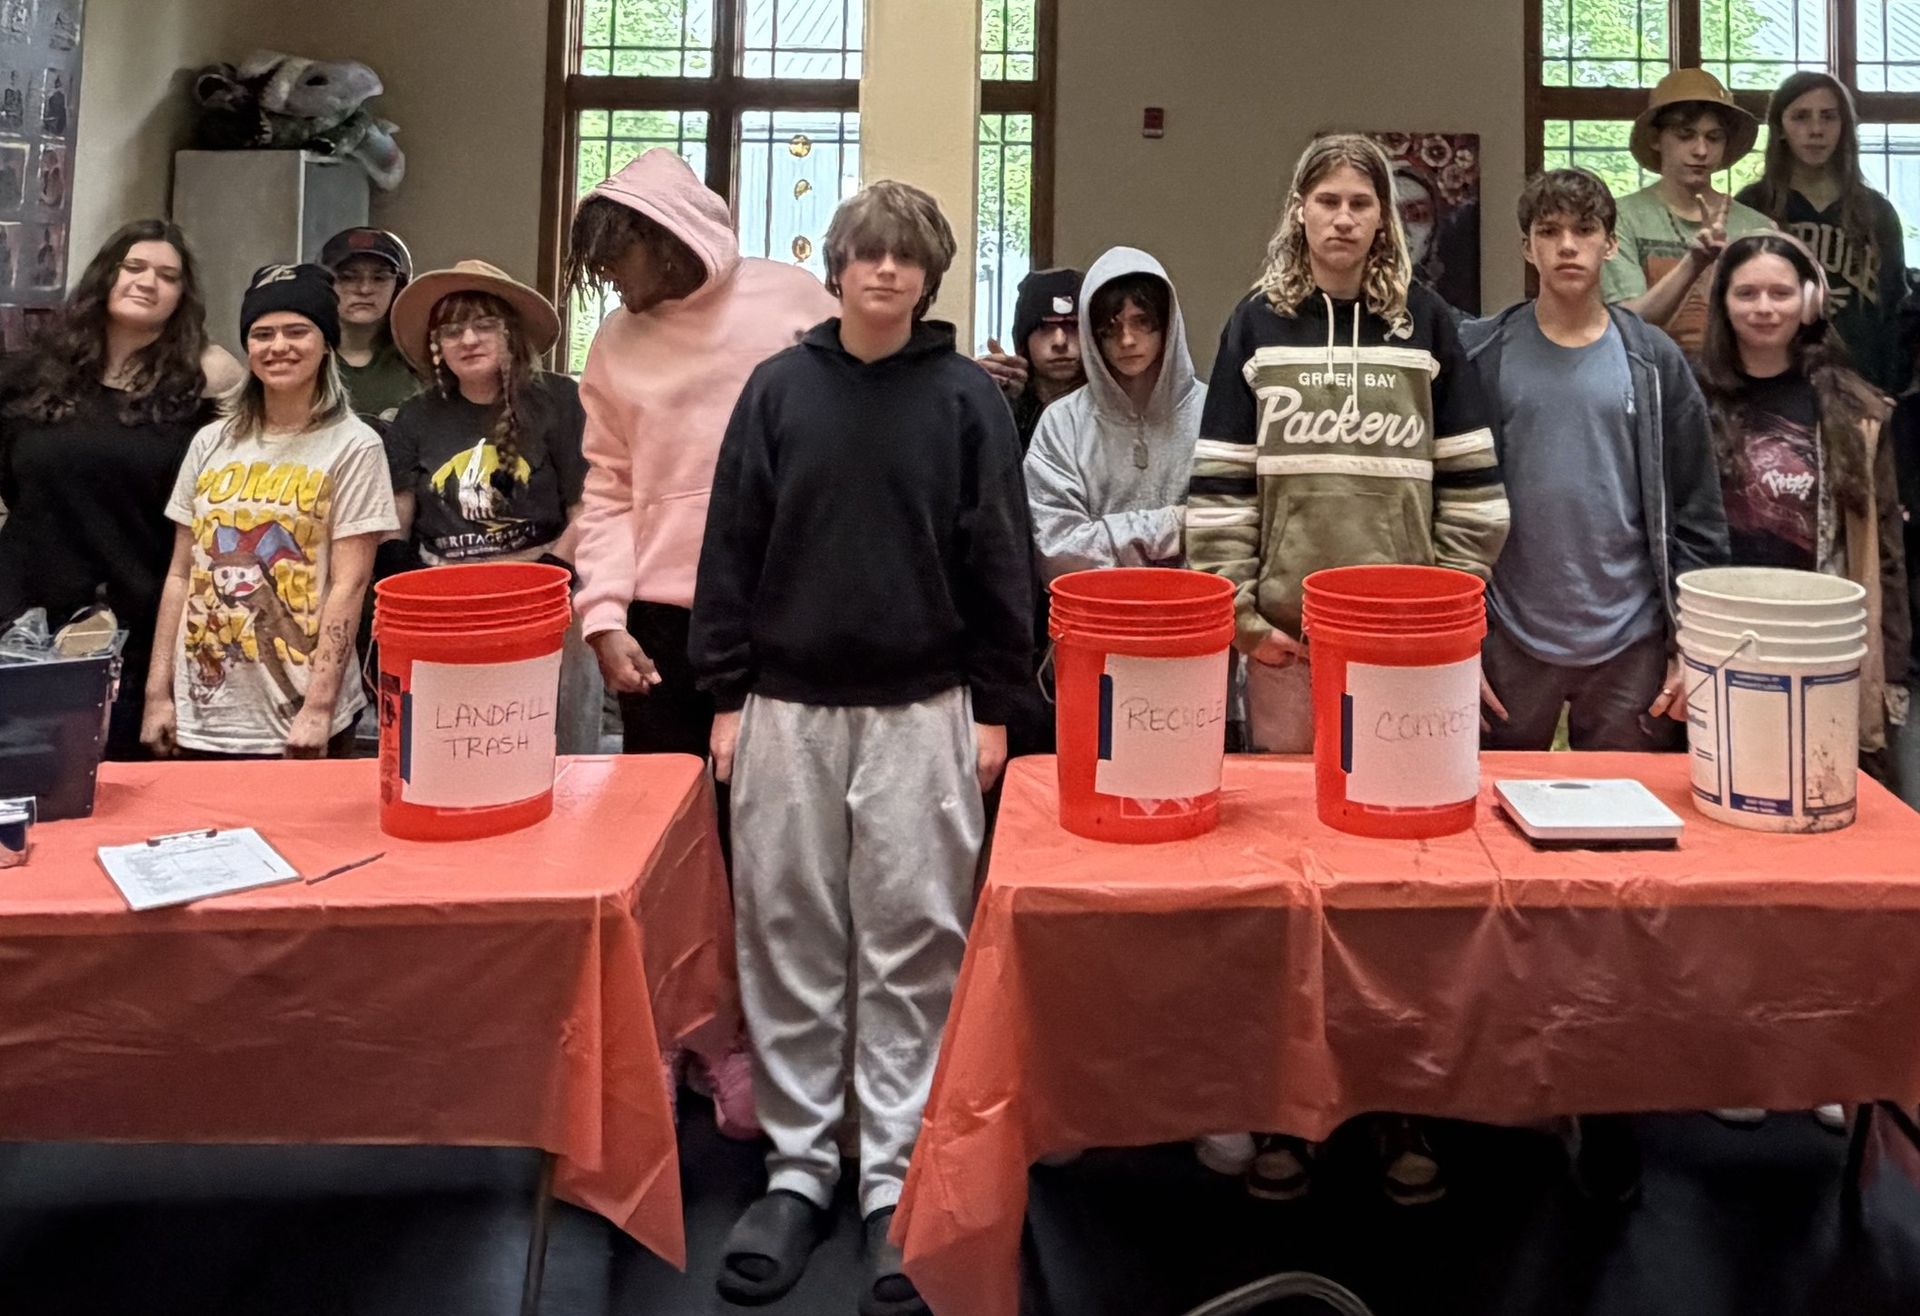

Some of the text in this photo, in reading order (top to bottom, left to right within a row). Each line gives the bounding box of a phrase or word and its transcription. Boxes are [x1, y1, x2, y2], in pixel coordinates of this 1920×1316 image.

[1364, 373, 1397, 389] BAY
[1255, 385, 1425, 449] Packers
[435, 695, 550, 730] LANDFILL
[443, 729, 530, 761] TRASH
